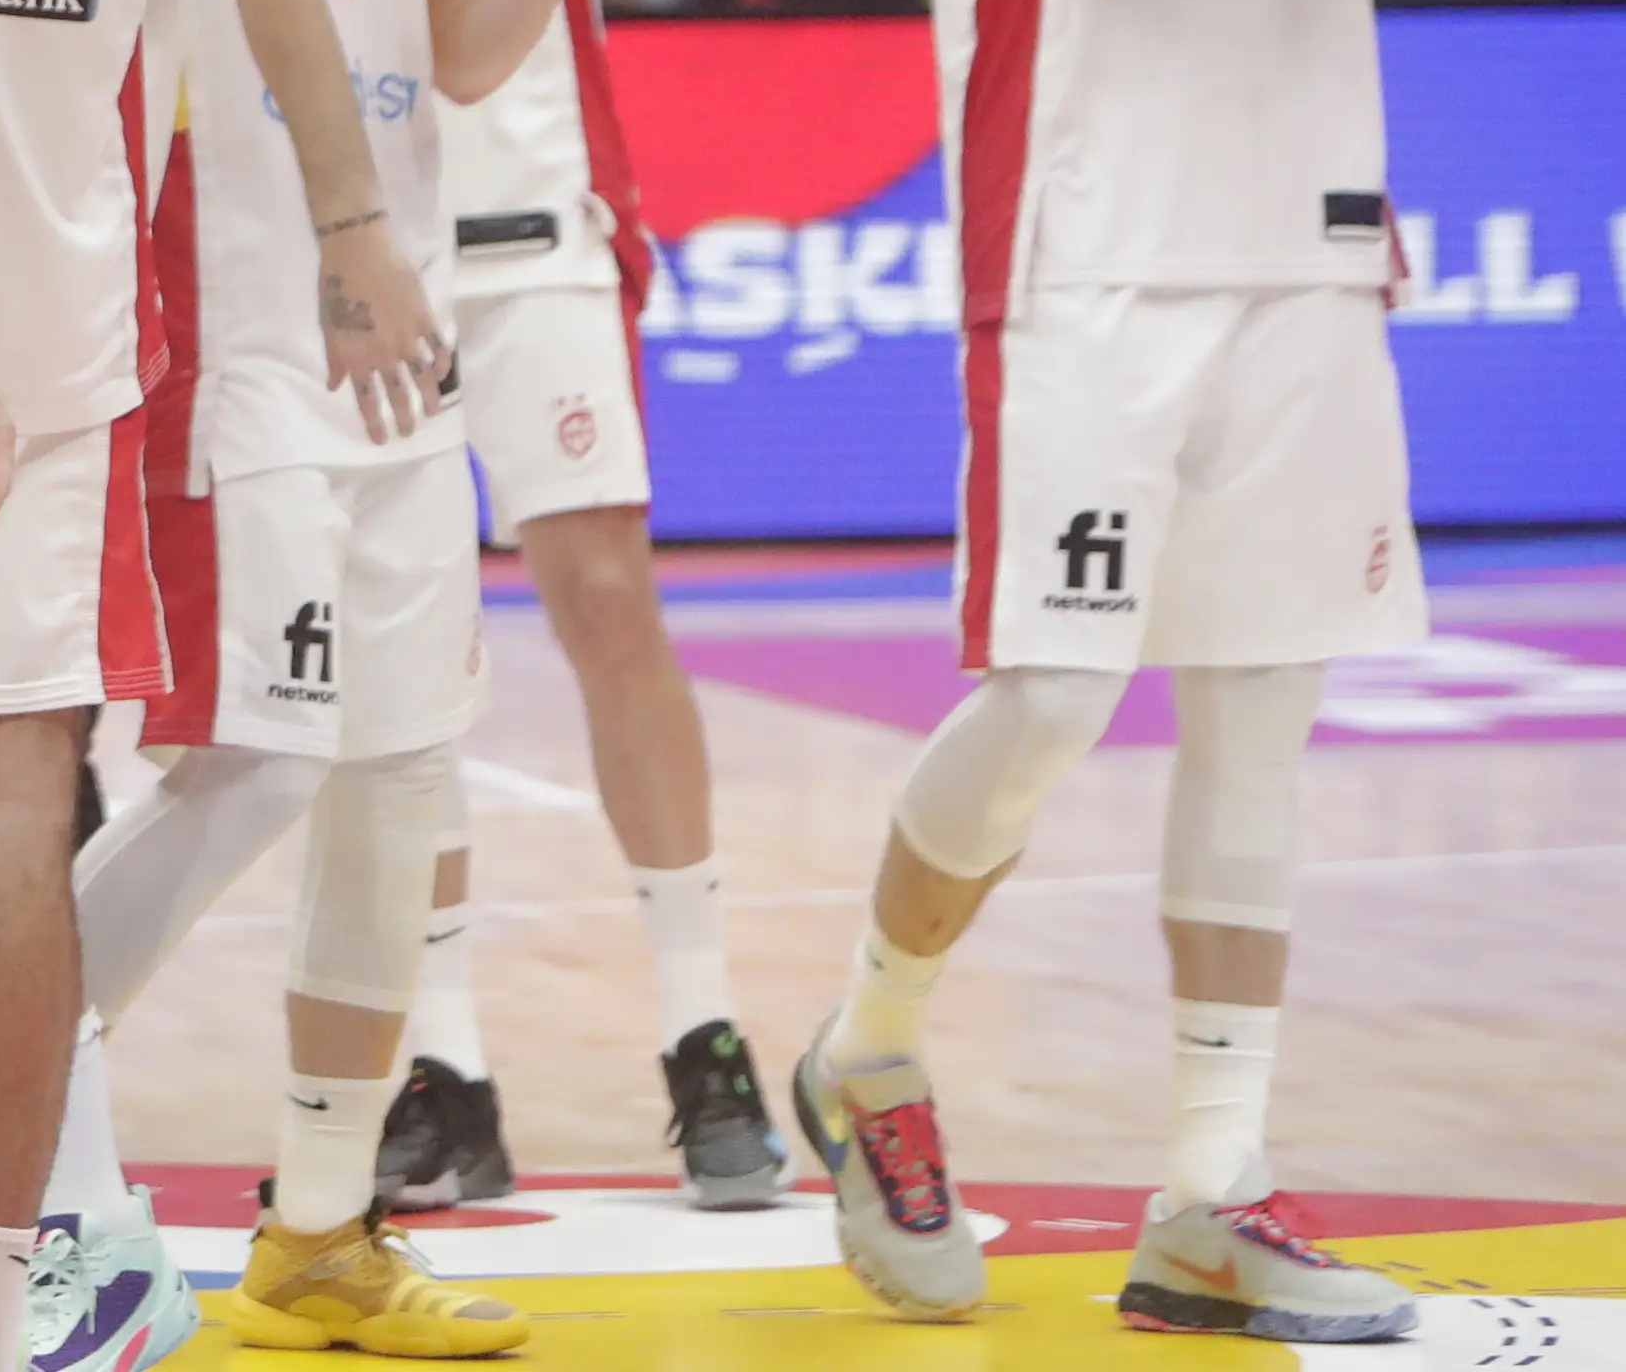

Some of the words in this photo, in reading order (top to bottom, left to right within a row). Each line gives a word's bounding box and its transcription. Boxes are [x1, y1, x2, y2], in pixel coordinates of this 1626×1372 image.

[1056, 508, 1126, 591] fi
[283, 600, 333, 683] fi
[267, 683, 340, 705] networ
